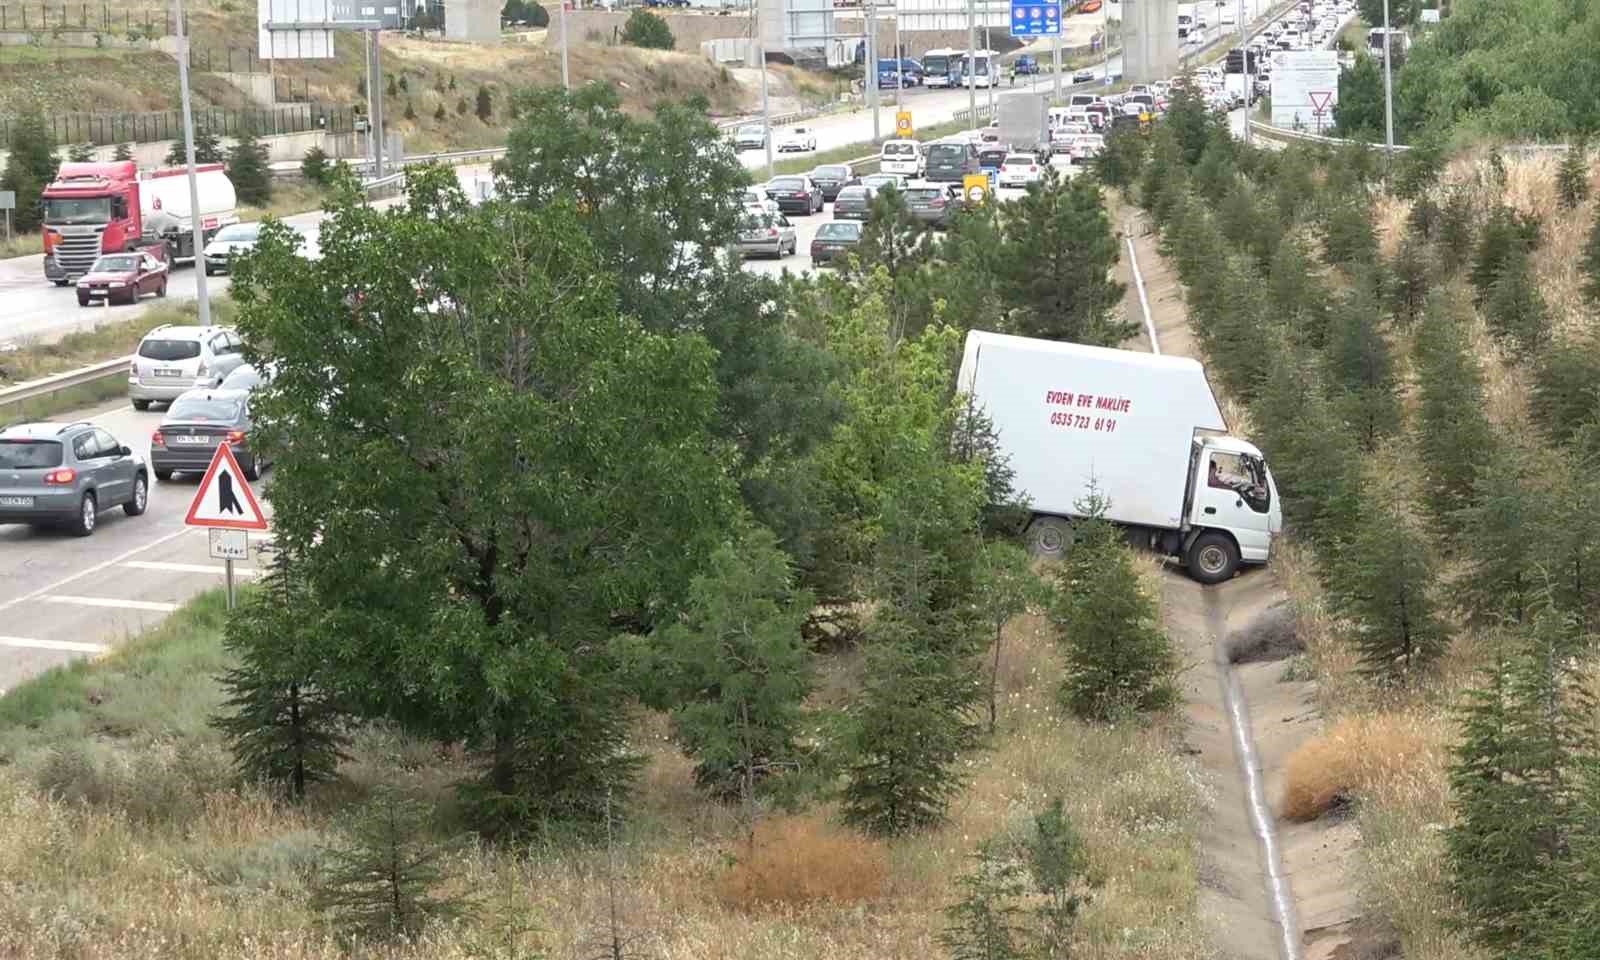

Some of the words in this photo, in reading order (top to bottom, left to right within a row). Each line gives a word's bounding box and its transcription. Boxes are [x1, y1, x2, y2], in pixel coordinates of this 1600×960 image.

[1046, 391, 1073, 405] EVDEN
[1077, 394, 1093, 408] EVE
[1051, 412, 1072, 426] 0535
[1074, 415, 1090, 429] 723
